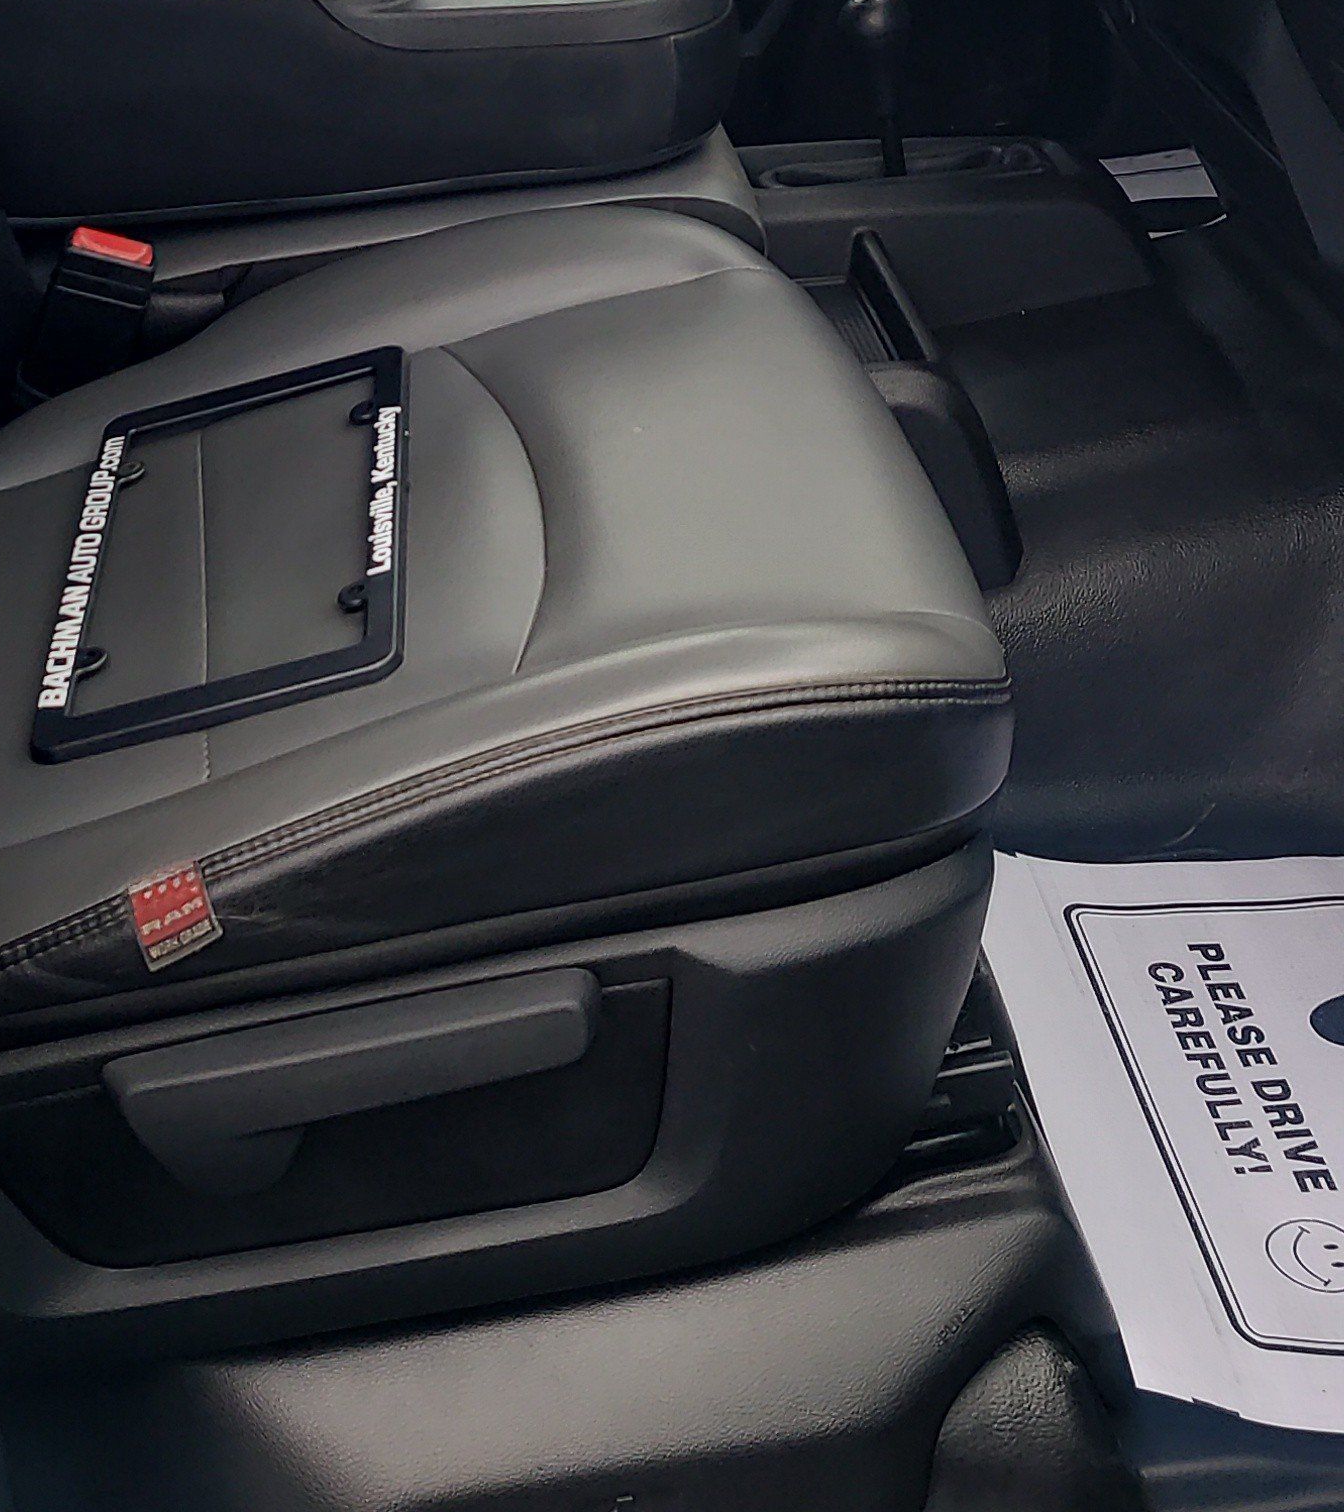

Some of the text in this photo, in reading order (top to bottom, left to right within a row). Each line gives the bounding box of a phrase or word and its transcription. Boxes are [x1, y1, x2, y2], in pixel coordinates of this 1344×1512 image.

[38, 435, 125, 709] BACHMAN AUTO GROUP.com
[367, 405, 402, 577] Louisville, Kentucky
[140, 896, 204, 936] RAM
[1147, 961, 1274, 1175] CAREFULLY!
[1187, 942, 1339, 1193] PLEASE DRIVE
